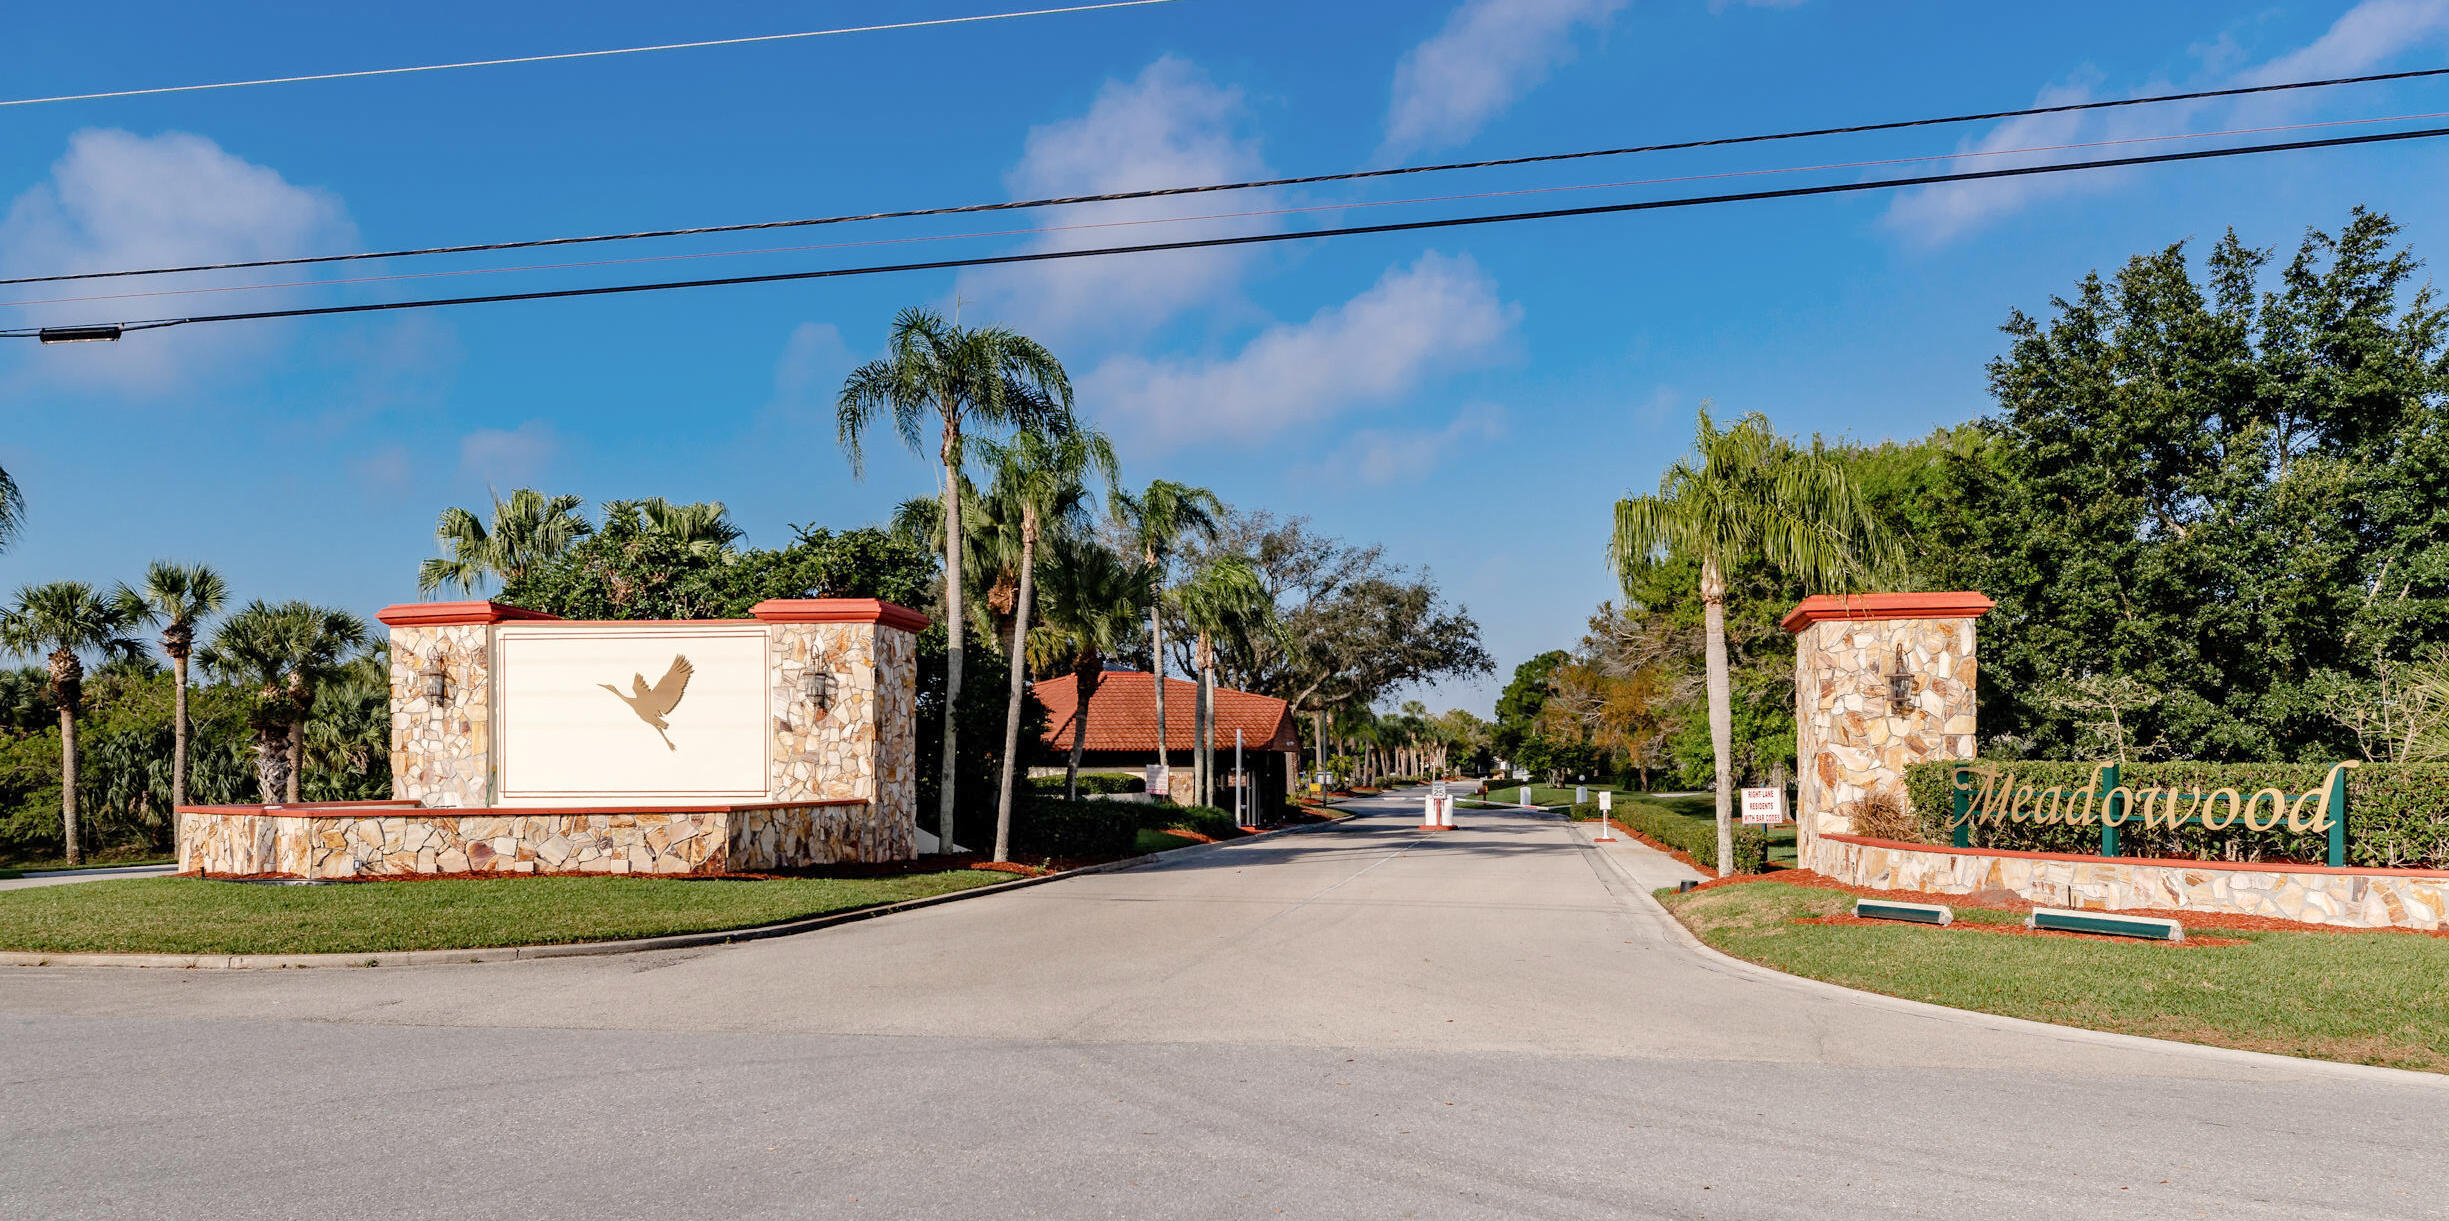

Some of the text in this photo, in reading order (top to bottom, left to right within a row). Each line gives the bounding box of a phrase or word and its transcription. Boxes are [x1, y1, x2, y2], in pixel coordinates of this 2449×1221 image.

[1433, 789, 1445, 797] 25
[1748, 790, 1774, 798] RIGHT LANE
[1946, 760, 2360, 834] Meadowood
[1749, 802, 1774, 810] RESIDENTS
[1744, 814, 1755, 822] WITH
